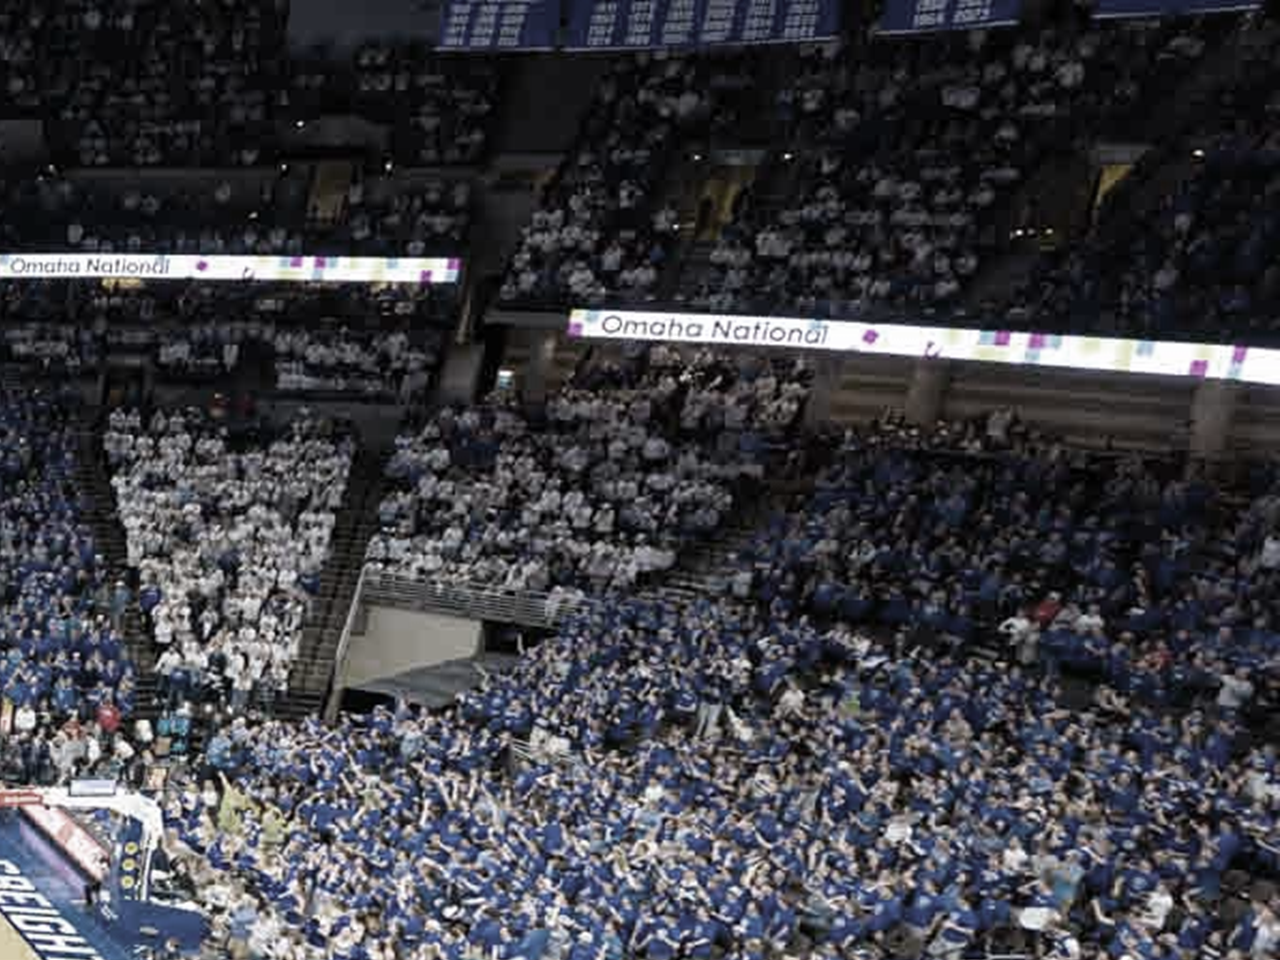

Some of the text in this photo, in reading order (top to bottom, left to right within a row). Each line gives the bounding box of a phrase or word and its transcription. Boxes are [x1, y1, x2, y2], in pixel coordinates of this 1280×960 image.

[10, 256, 170, 275] Omaha National
[601, 314, 830, 345] Omaha National
